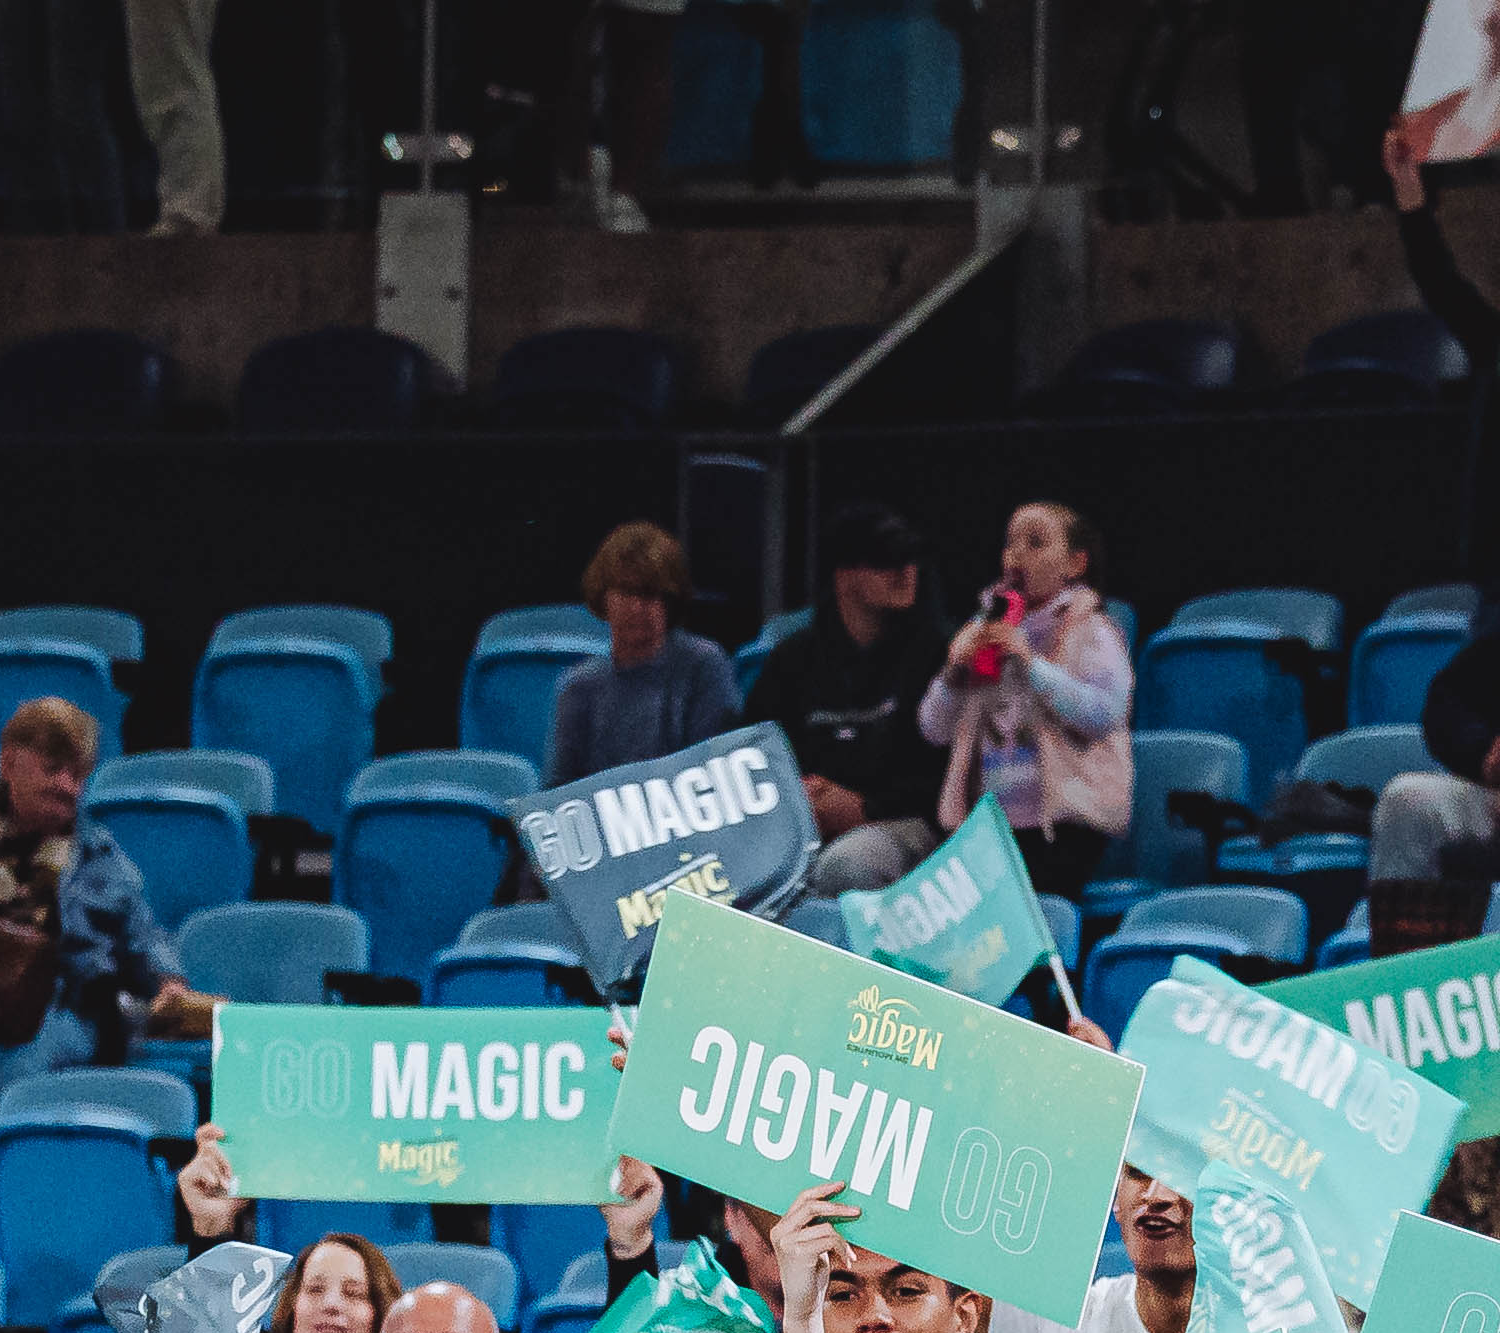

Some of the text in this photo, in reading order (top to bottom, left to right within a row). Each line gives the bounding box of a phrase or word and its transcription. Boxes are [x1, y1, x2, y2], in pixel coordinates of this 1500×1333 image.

[521, 746, 780, 880] GO MAGIC
[263, 1040, 585, 1121] GO MAGIC
[847, 1009, 944, 1071] Magic
[379, 1142, 460, 1173] Magic
[679, 1026, 1052, 1254] GO MAGIC
